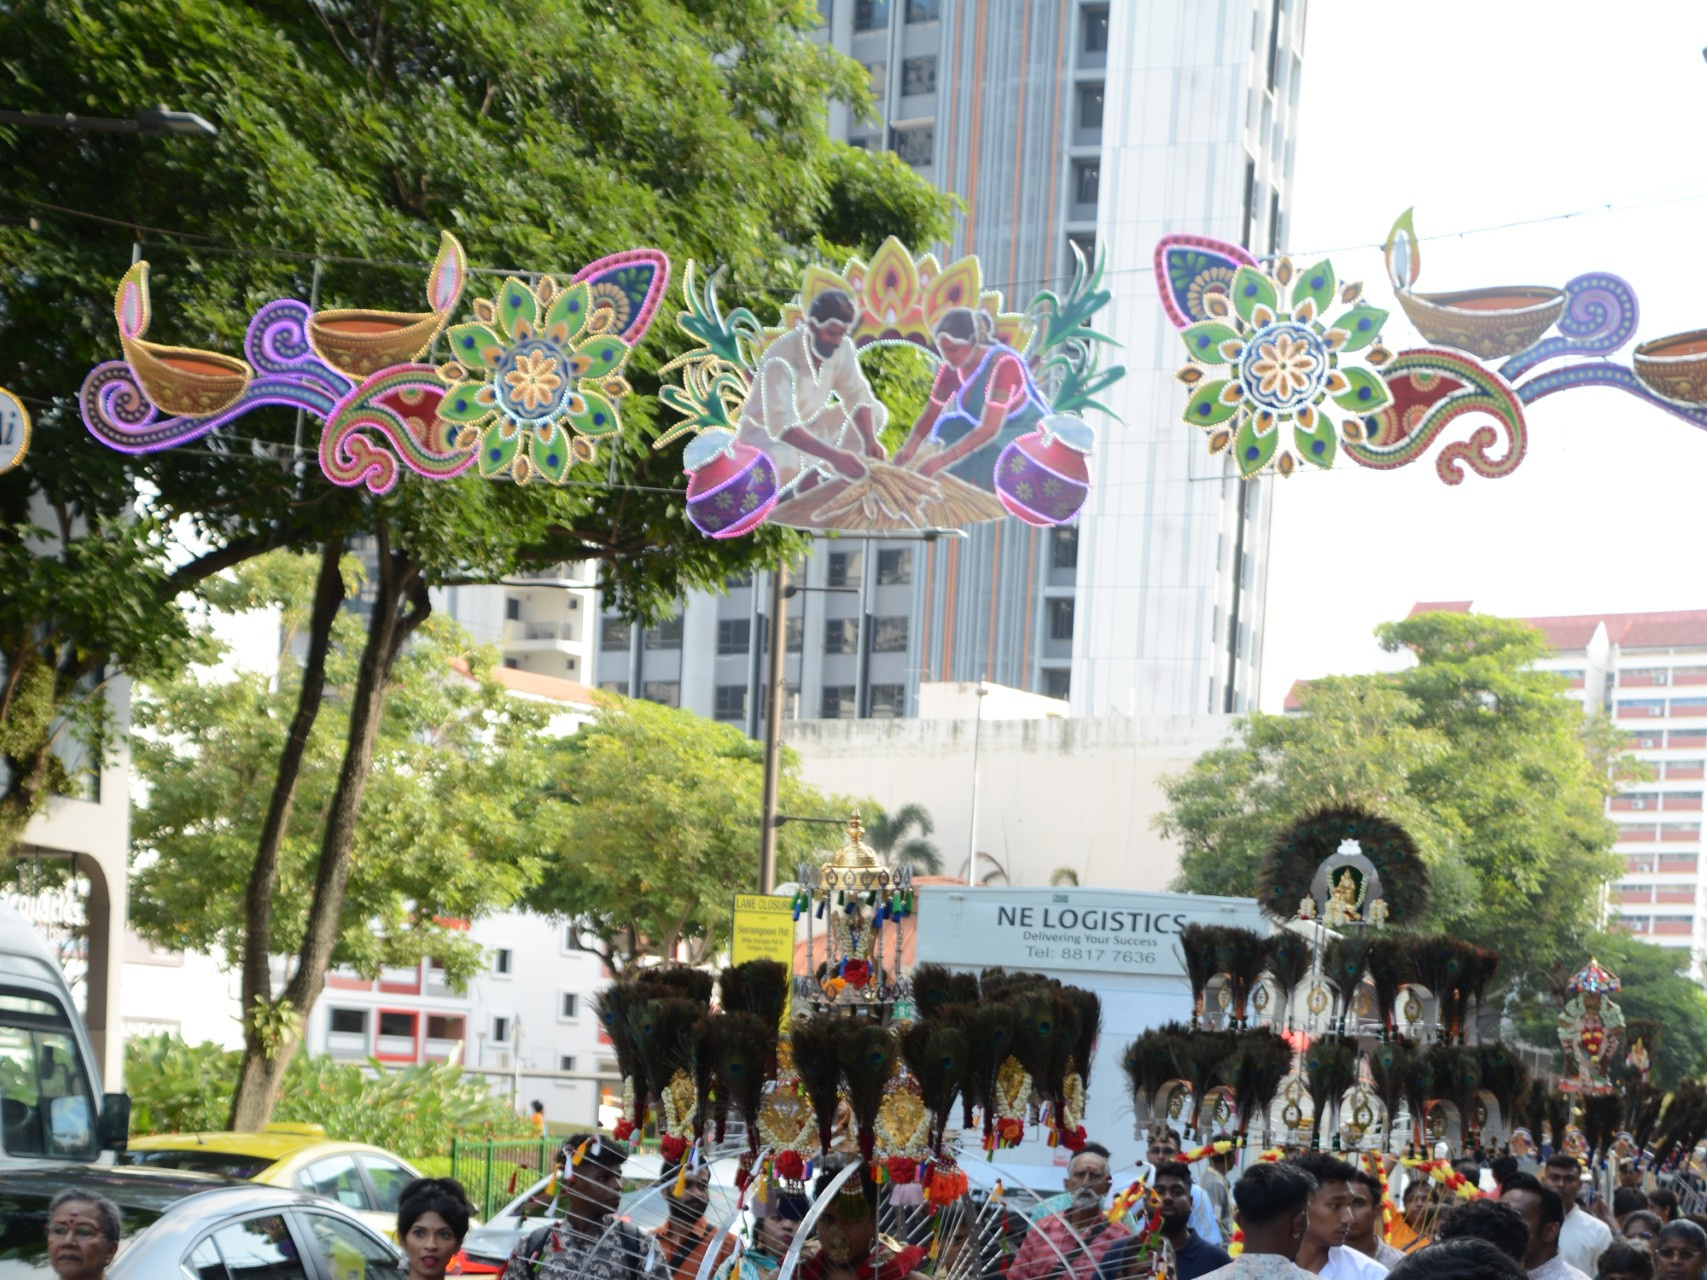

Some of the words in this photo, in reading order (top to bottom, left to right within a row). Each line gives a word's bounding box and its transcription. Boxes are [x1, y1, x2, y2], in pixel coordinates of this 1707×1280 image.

[736, 897, 756, 909] LANE
[997, 905, 1034, 927] NE
[1043, 907, 1187, 934] LOGISTICS
[737, 924, 777, 936] Serangoon
[778, 926, 789, 936] Rd
[1023, 930, 1081, 945] Delivering
[1084, 933, 1110, 944] Your
[1113, 935, 1158, 946] Success
[1024, 945, 1055, 959] Tel:
[1061, 948, 1105, 961] 8817
[1112, 950, 1156, 964] 7636
